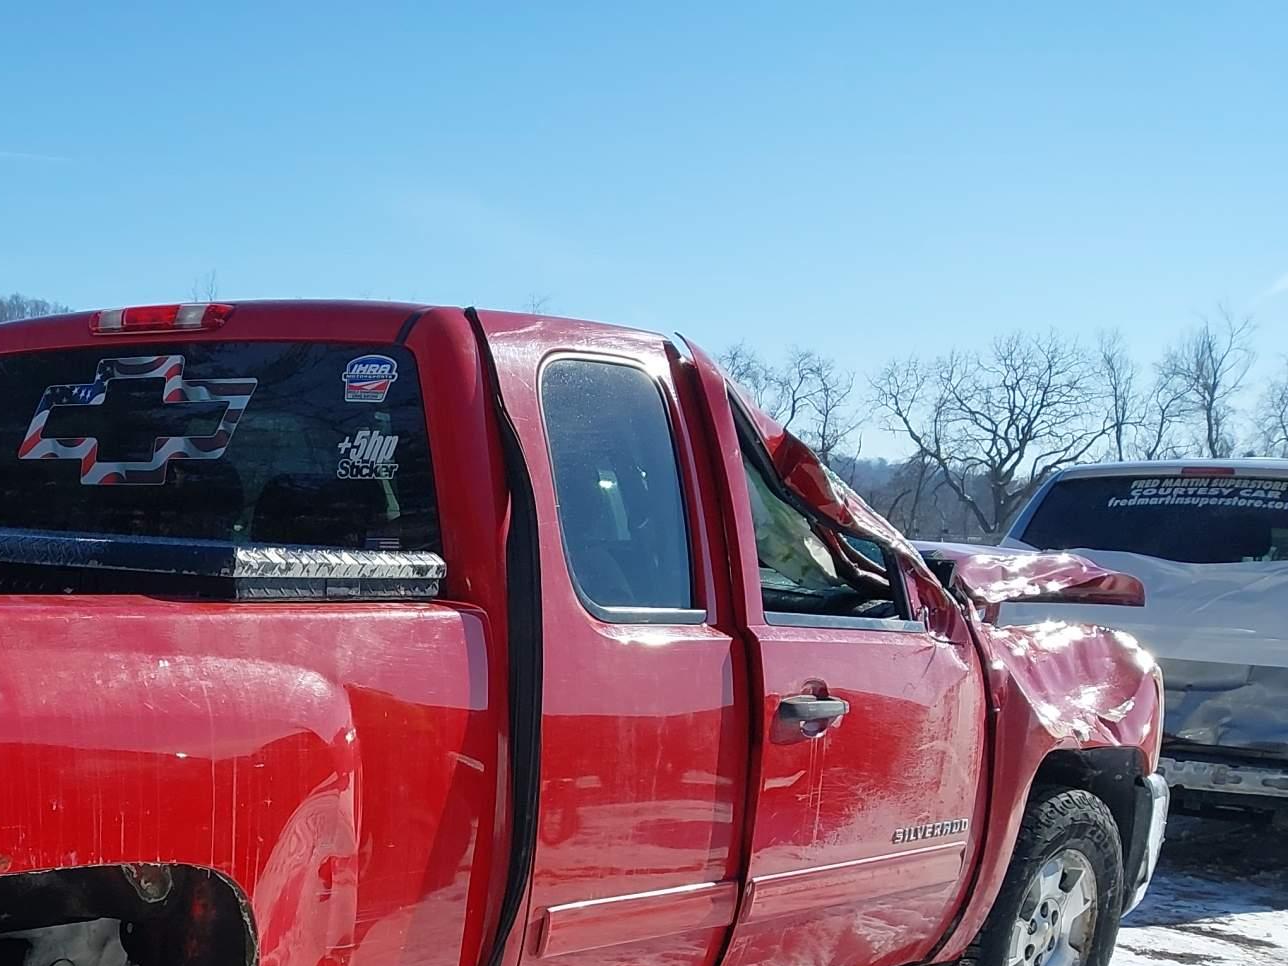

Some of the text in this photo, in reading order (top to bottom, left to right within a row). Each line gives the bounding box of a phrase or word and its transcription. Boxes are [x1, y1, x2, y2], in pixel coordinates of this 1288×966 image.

[351, 364, 392, 374] IHRA
[337, 459, 399, 480] Sticker
[1131, 478, 1288, 491] FRED MARTIN SUPERSTORE
[1130, 487, 1283, 499] COURTESY CAR
[892, 818, 969, 844] SILVERADO
